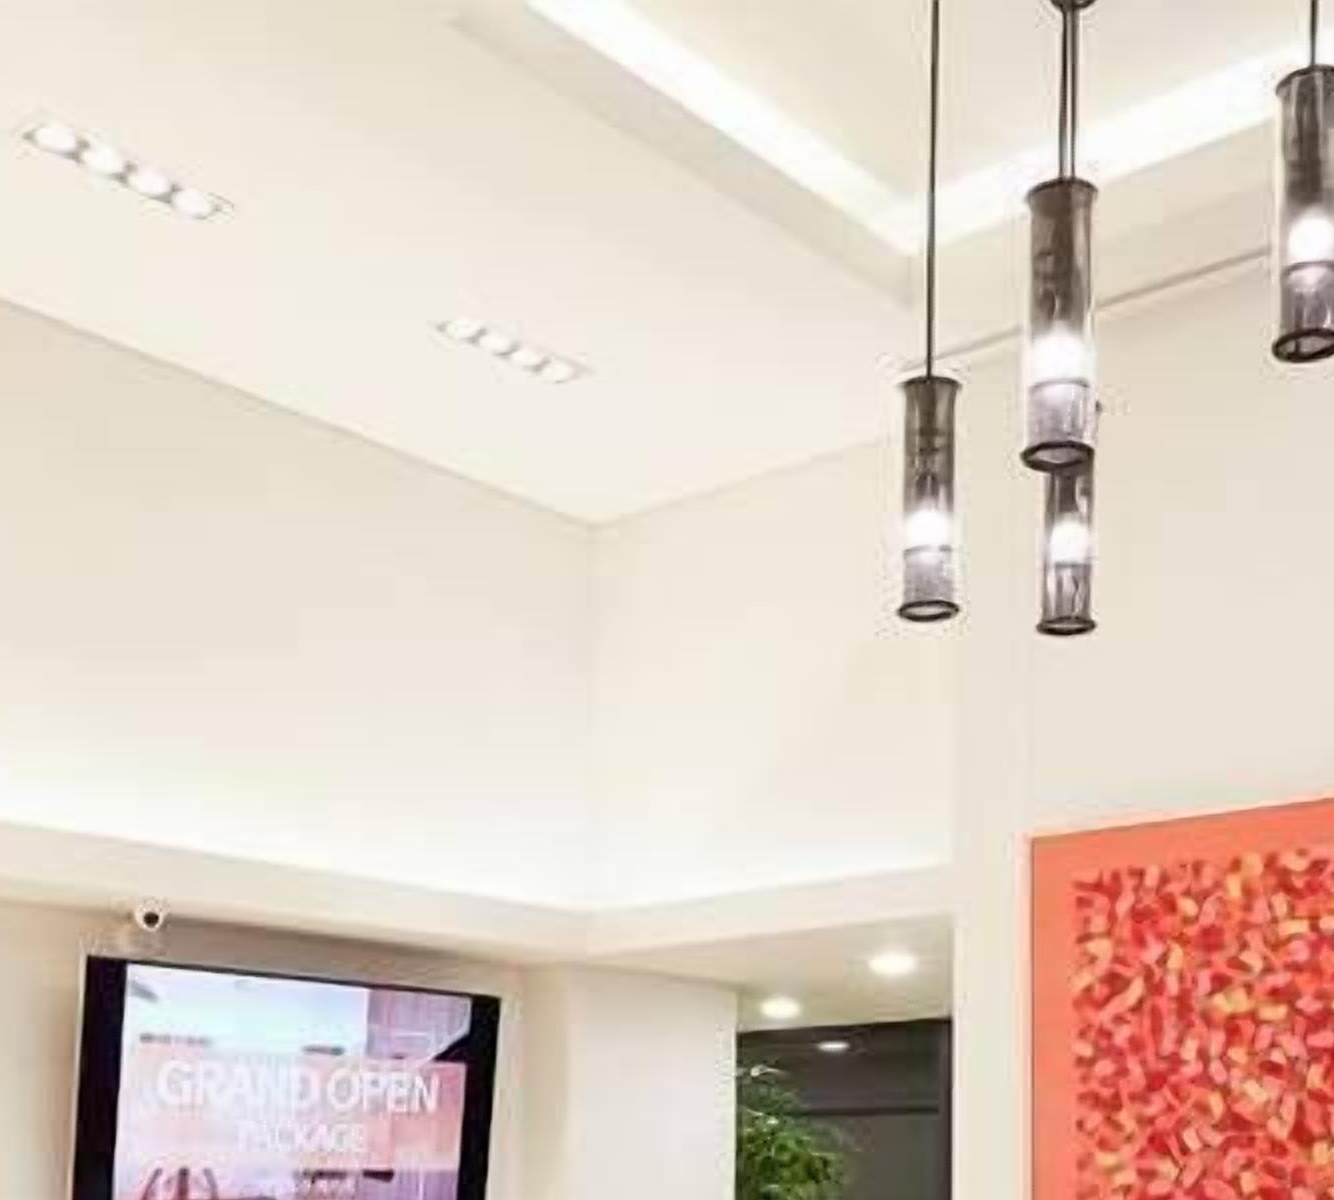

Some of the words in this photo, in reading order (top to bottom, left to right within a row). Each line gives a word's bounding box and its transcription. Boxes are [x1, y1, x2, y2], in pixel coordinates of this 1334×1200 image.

[157, 1058, 320, 1110] GRAND
[327, 1065, 440, 1113] OPEN
[236, 1119, 365, 1153] PACKAGE
